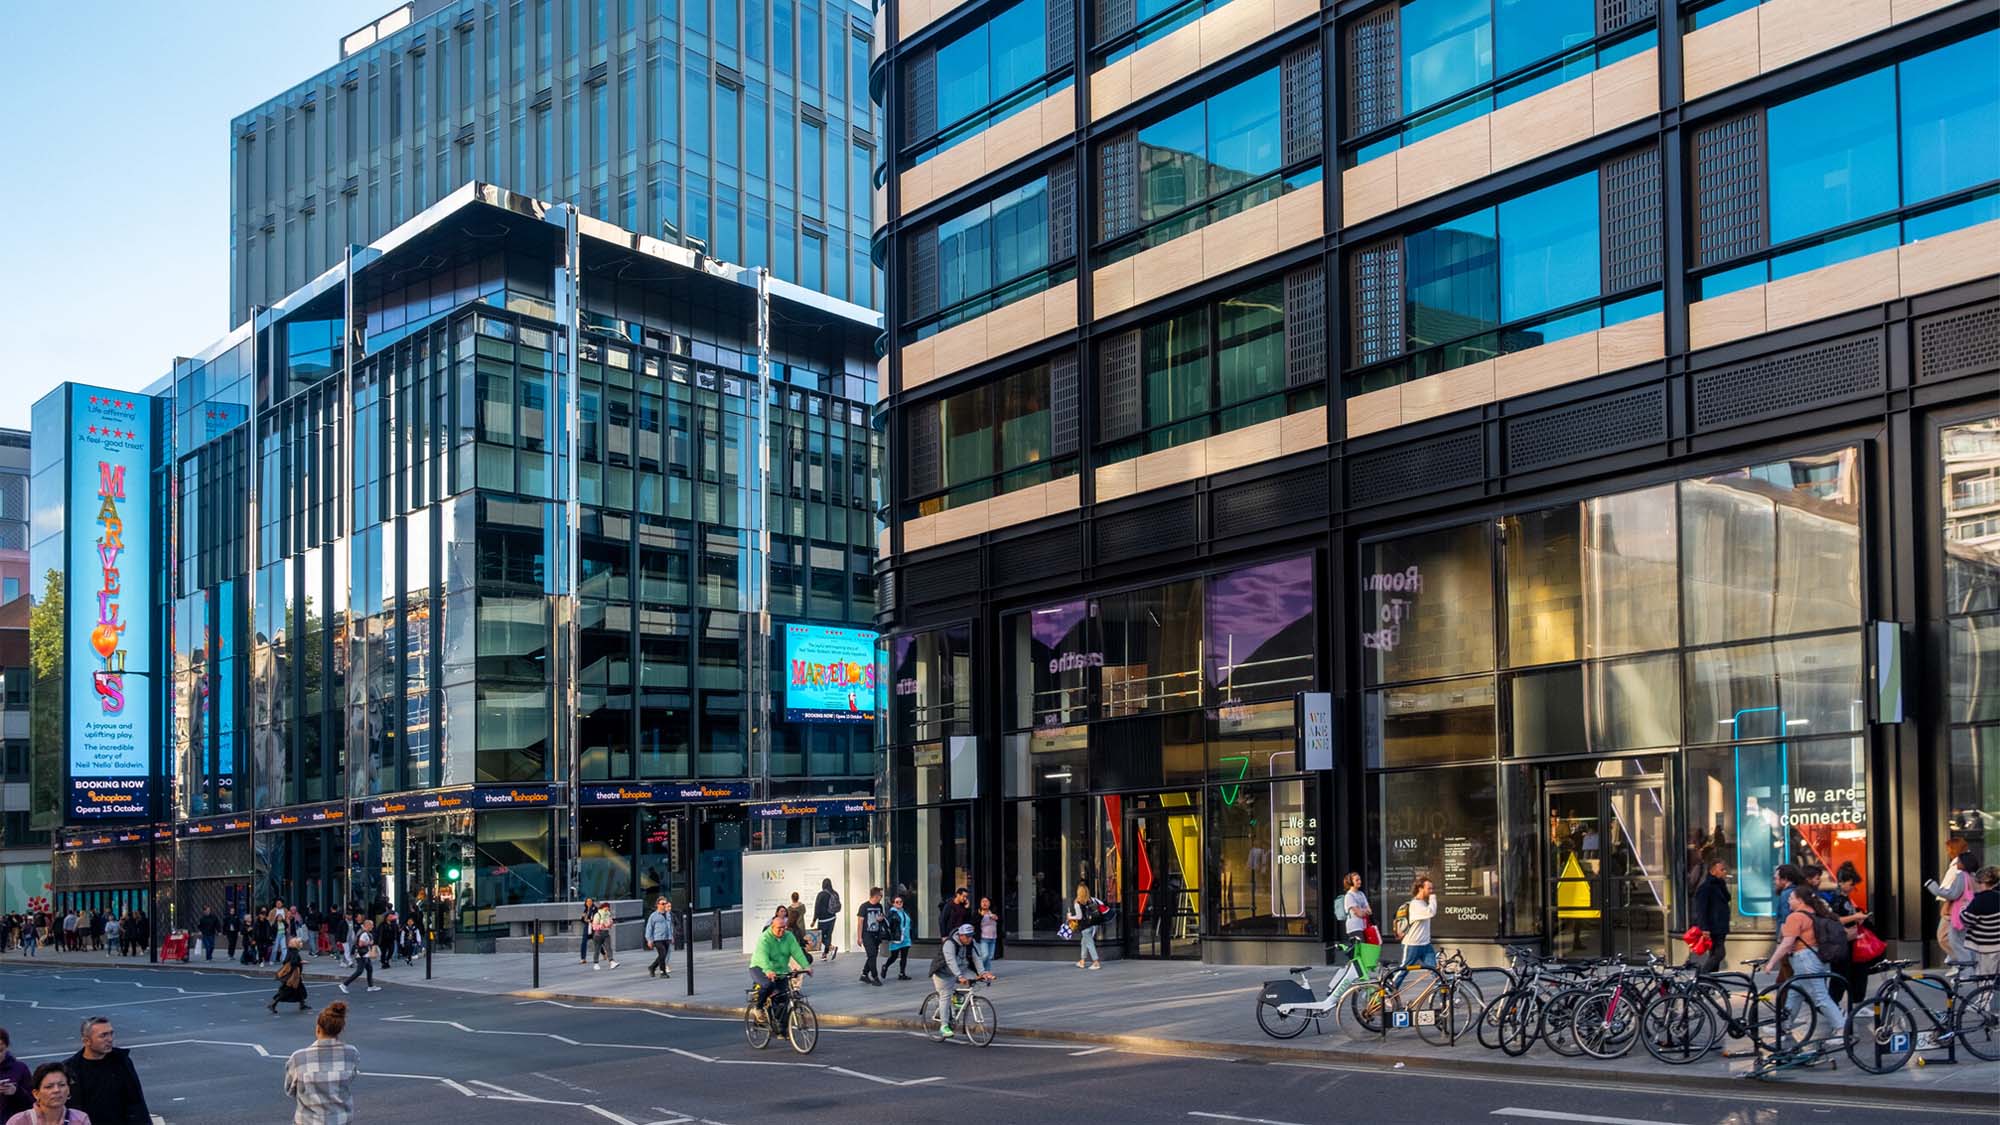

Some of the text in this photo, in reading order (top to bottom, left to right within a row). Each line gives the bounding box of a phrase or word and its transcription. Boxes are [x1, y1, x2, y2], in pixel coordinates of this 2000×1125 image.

[92, 461, 126, 713] MARVELLOUS
[792, 659, 875, 689] MARVELLOUS
[93, 722, 117, 730] joyous
[84, 731, 115, 739] uplifting
[75, 780, 144, 789] BOOKING NOW
[596, 791, 620, 799] theatre
[680, 789, 702, 797] theatre
[1794, 787, 1856, 803] We are
[485, 794, 512, 803] theatre
[75, 805, 101, 815] Opens
[113, 804, 144, 813] October
[761, 808, 782, 816] theatre
[1289, 816, 1304, 828] We
[1279, 835, 1316, 846] where
[1394, 839, 1418, 849] ONE
[1277, 852, 1305, 865] need
[1444, 906, 1477, 914] DERWENT
